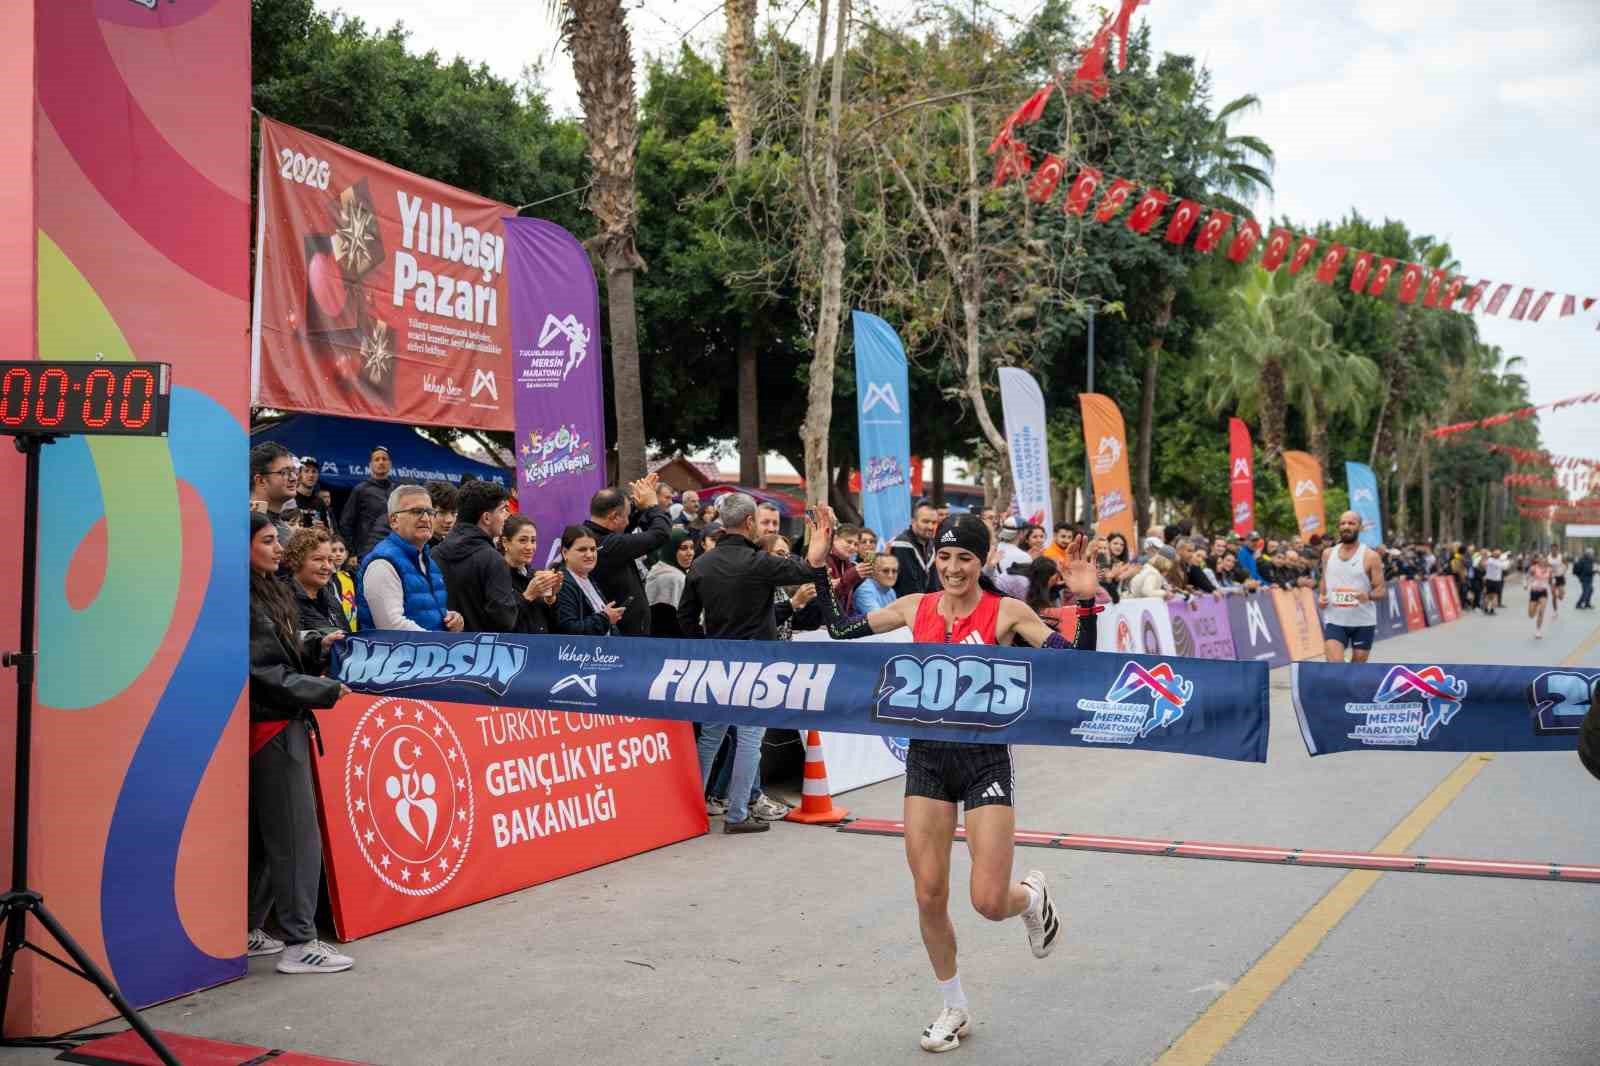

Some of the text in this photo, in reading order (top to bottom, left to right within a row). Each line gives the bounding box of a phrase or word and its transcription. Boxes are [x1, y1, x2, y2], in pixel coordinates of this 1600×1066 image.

[281, 148, 329, 190] 2026
[397, 190, 505, 283] Yılbaşı
[393, 251, 497, 326] Pazarı
[523, 369, 562, 377] MARATONU
[531, 357, 564, 368] MERSİN
[339, 633, 528, 686] MERSİN
[559, 644, 591, 671] Vahap
[648, 659, 836, 711] FINISH
[887, 657, 1028, 715] 2025
[1547, 675, 1597, 716] 2
[1095, 712, 1144, 725] MERSİN
[1356, 726, 1419, 735] MARATONU
[1368, 710, 1421, 724] MERSİN
[485, 732, 671, 797] GENÇLİK VE SPOR
[492, 784, 617, 848] BAKANLIĞI
